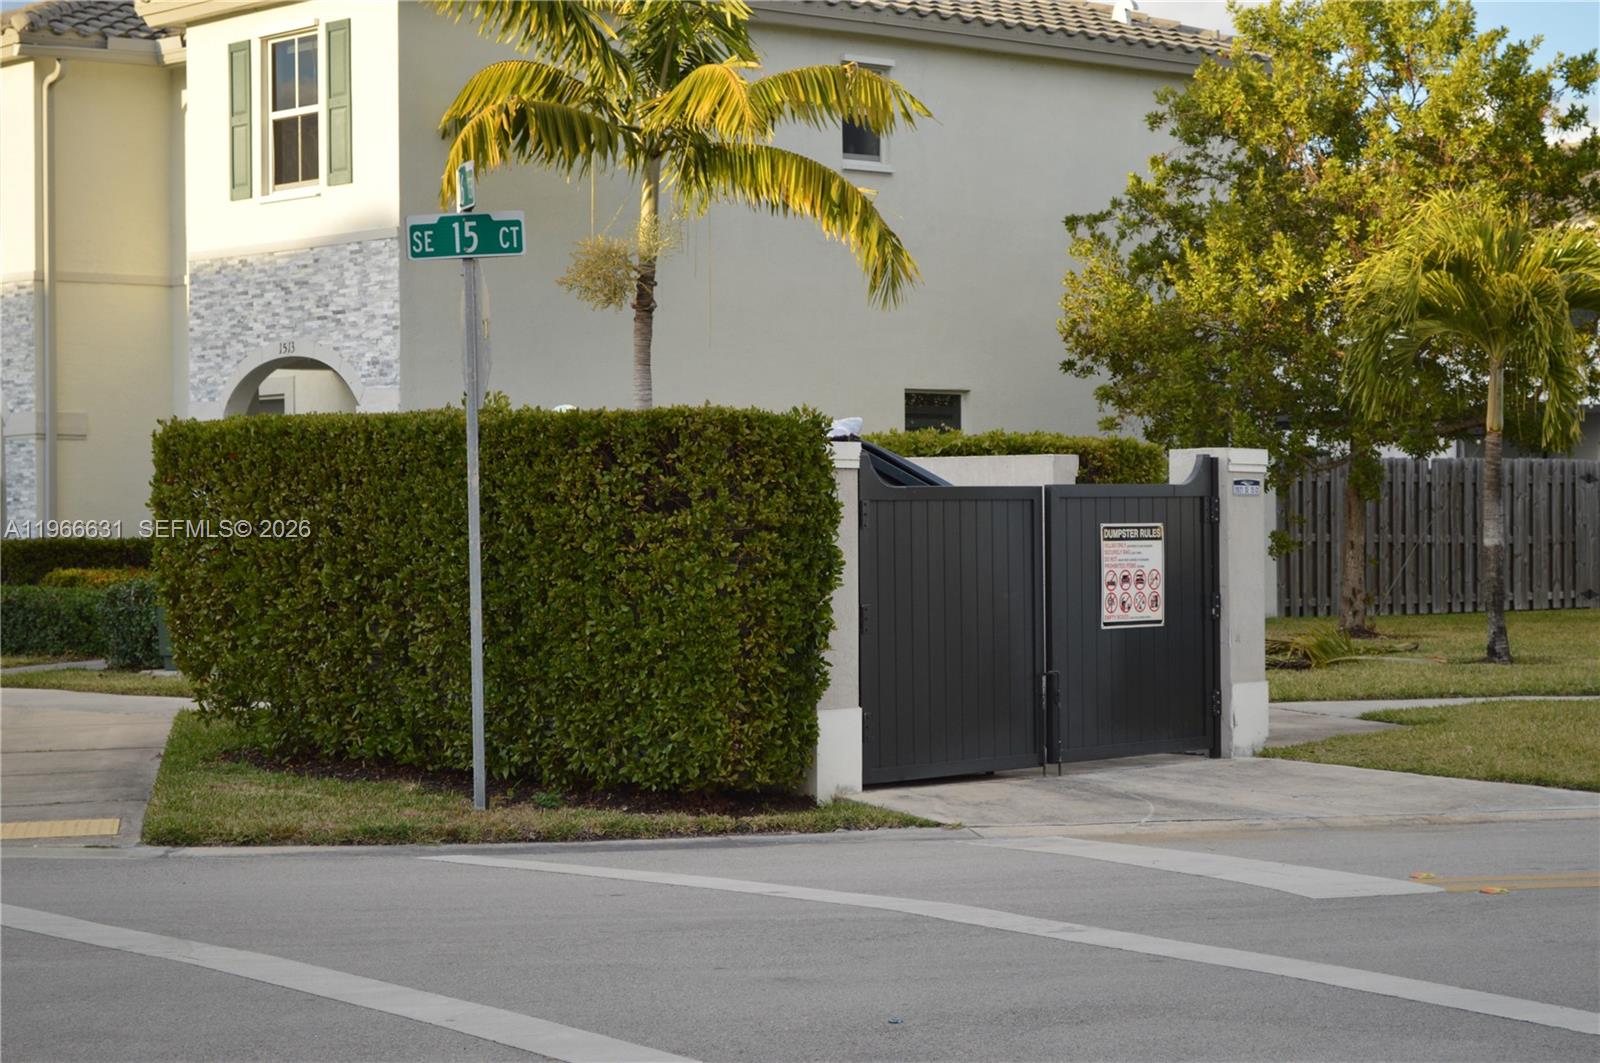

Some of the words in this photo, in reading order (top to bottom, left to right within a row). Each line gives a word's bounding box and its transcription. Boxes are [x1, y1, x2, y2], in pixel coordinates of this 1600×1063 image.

[412, 231, 434, 253] SE
[452, 221, 479, 254] 15
[499, 226, 519, 249] CT
[279, 341, 295, 354] 1513
[1103, 528, 1139, 539] DUMPSTER
[1139, 528, 1161, 538] RULES
